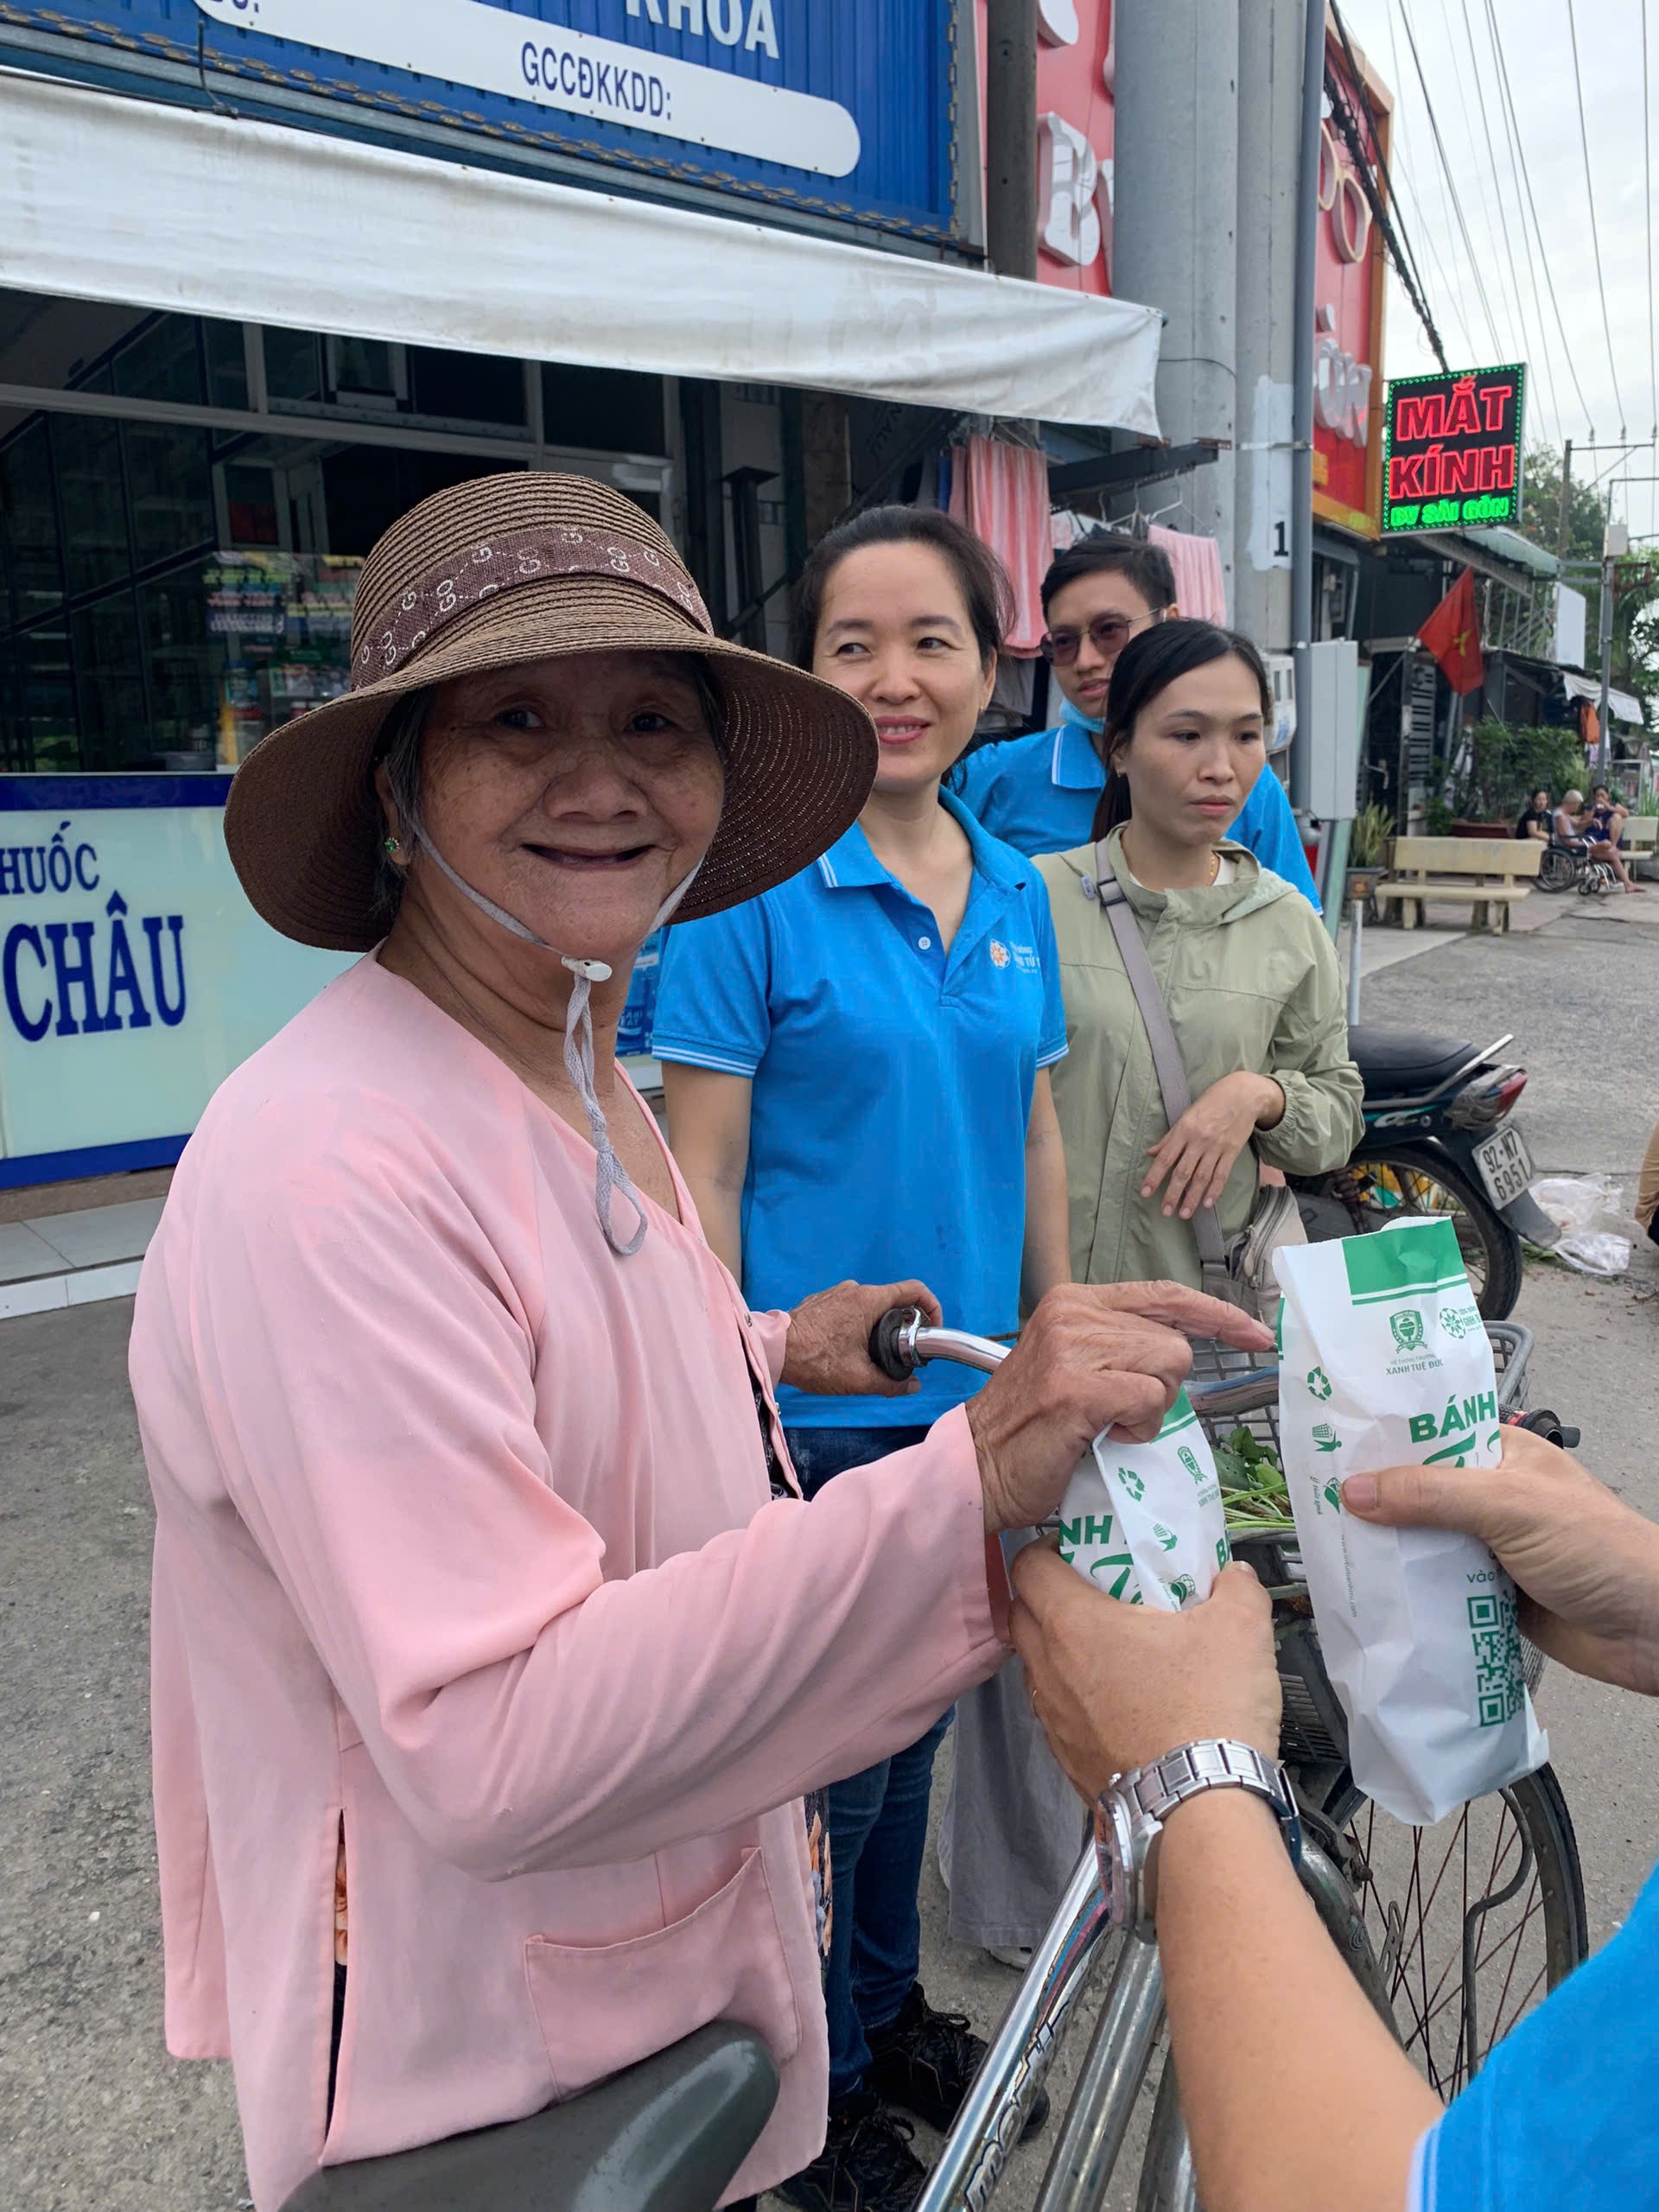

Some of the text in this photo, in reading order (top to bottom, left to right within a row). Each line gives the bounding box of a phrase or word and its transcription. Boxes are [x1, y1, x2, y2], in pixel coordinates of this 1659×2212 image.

[1396, 375, 1512, 441] MẮT
[1389, 444, 1515, 499] KÍNH
[1274, 521, 1288, 556] 1
[3, 890, 186, 1042] CHÂU
[1494, 1158, 1529, 1200] 6951
[1408, 1390, 1497, 1444] BÁNH
[1466, 1569, 1495, 1584] vào
